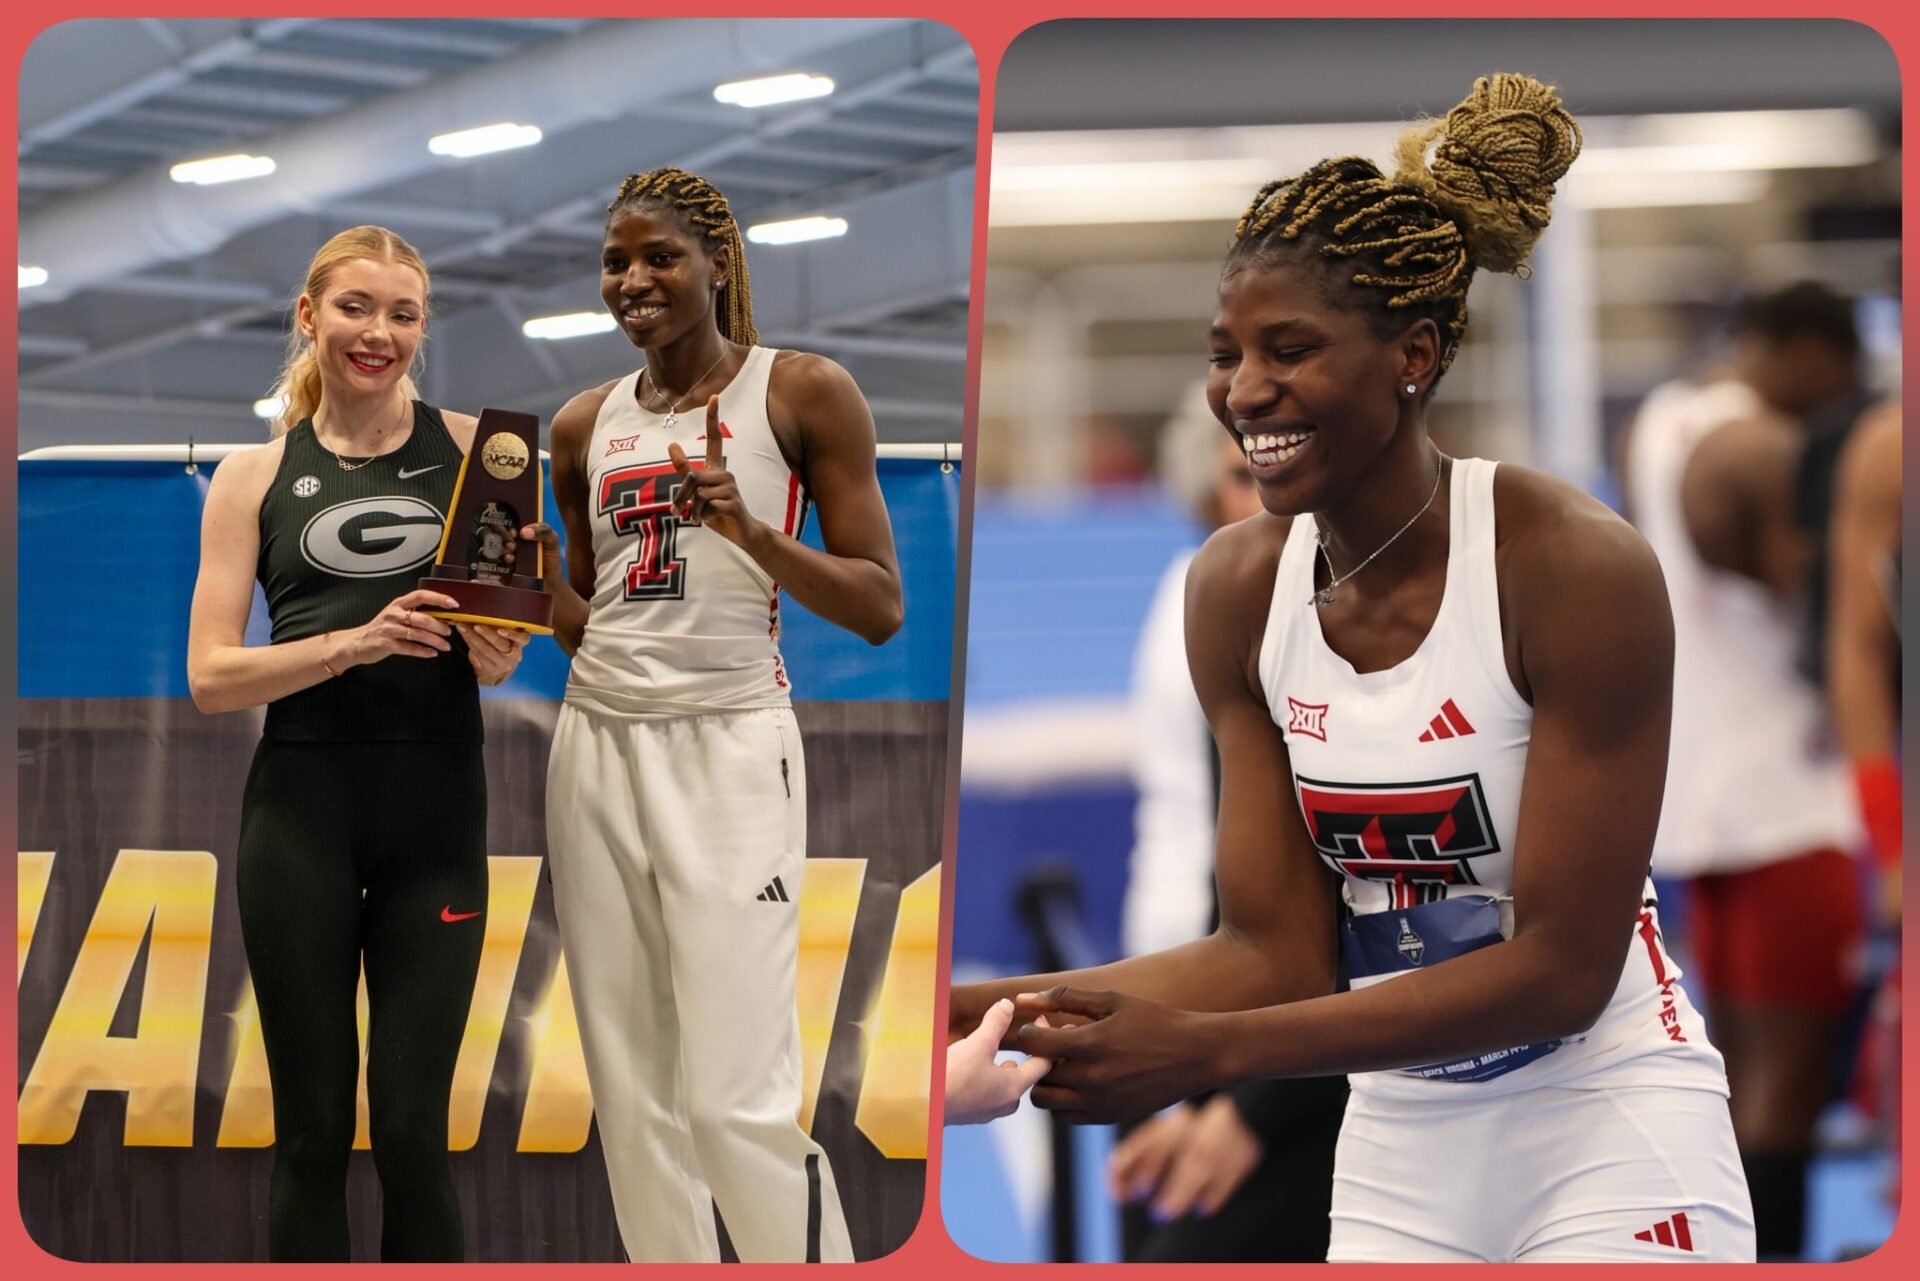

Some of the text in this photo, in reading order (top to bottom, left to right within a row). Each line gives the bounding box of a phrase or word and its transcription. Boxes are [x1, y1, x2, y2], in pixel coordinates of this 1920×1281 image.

[485, 452, 526, 469] NCAA
[295, 477, 319, 496] SEC
[303, 497, 445, 576] G
[1288, 696, 1329, 742] XII
[1445, 1060, 1475, 1075] VIRGINIA
[1480, 1049, 1509, 1066] MARCH
